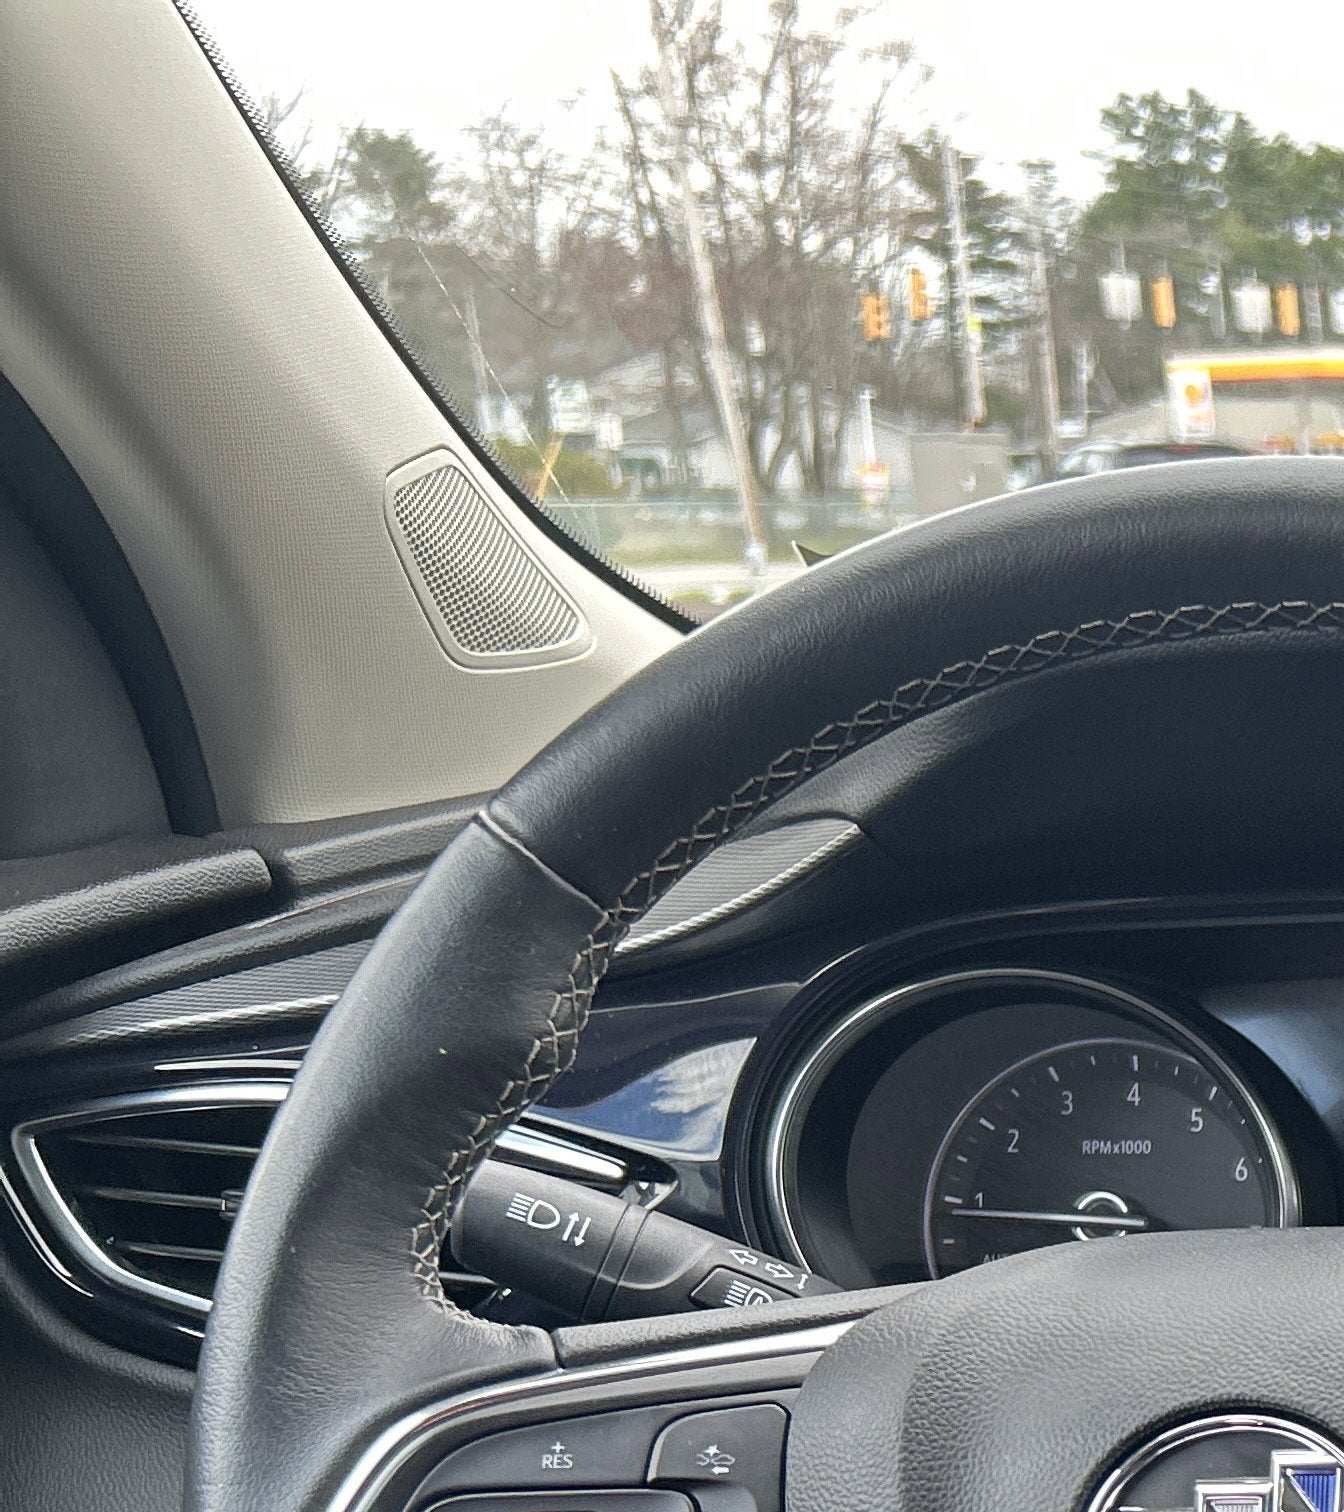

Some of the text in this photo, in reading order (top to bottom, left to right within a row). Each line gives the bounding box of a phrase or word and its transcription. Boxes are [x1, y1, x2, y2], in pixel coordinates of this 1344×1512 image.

[1061, 1091, 1074, 1115] 3
[1127, 1083, 1141, 1107] 4
[1191, 1108, 1204, 1133] 5
[1007, 1129, 1020, 1153] 2
[1234, 1158, 1248, 1182] 6
[541, 1453, 573, 1470] RES
